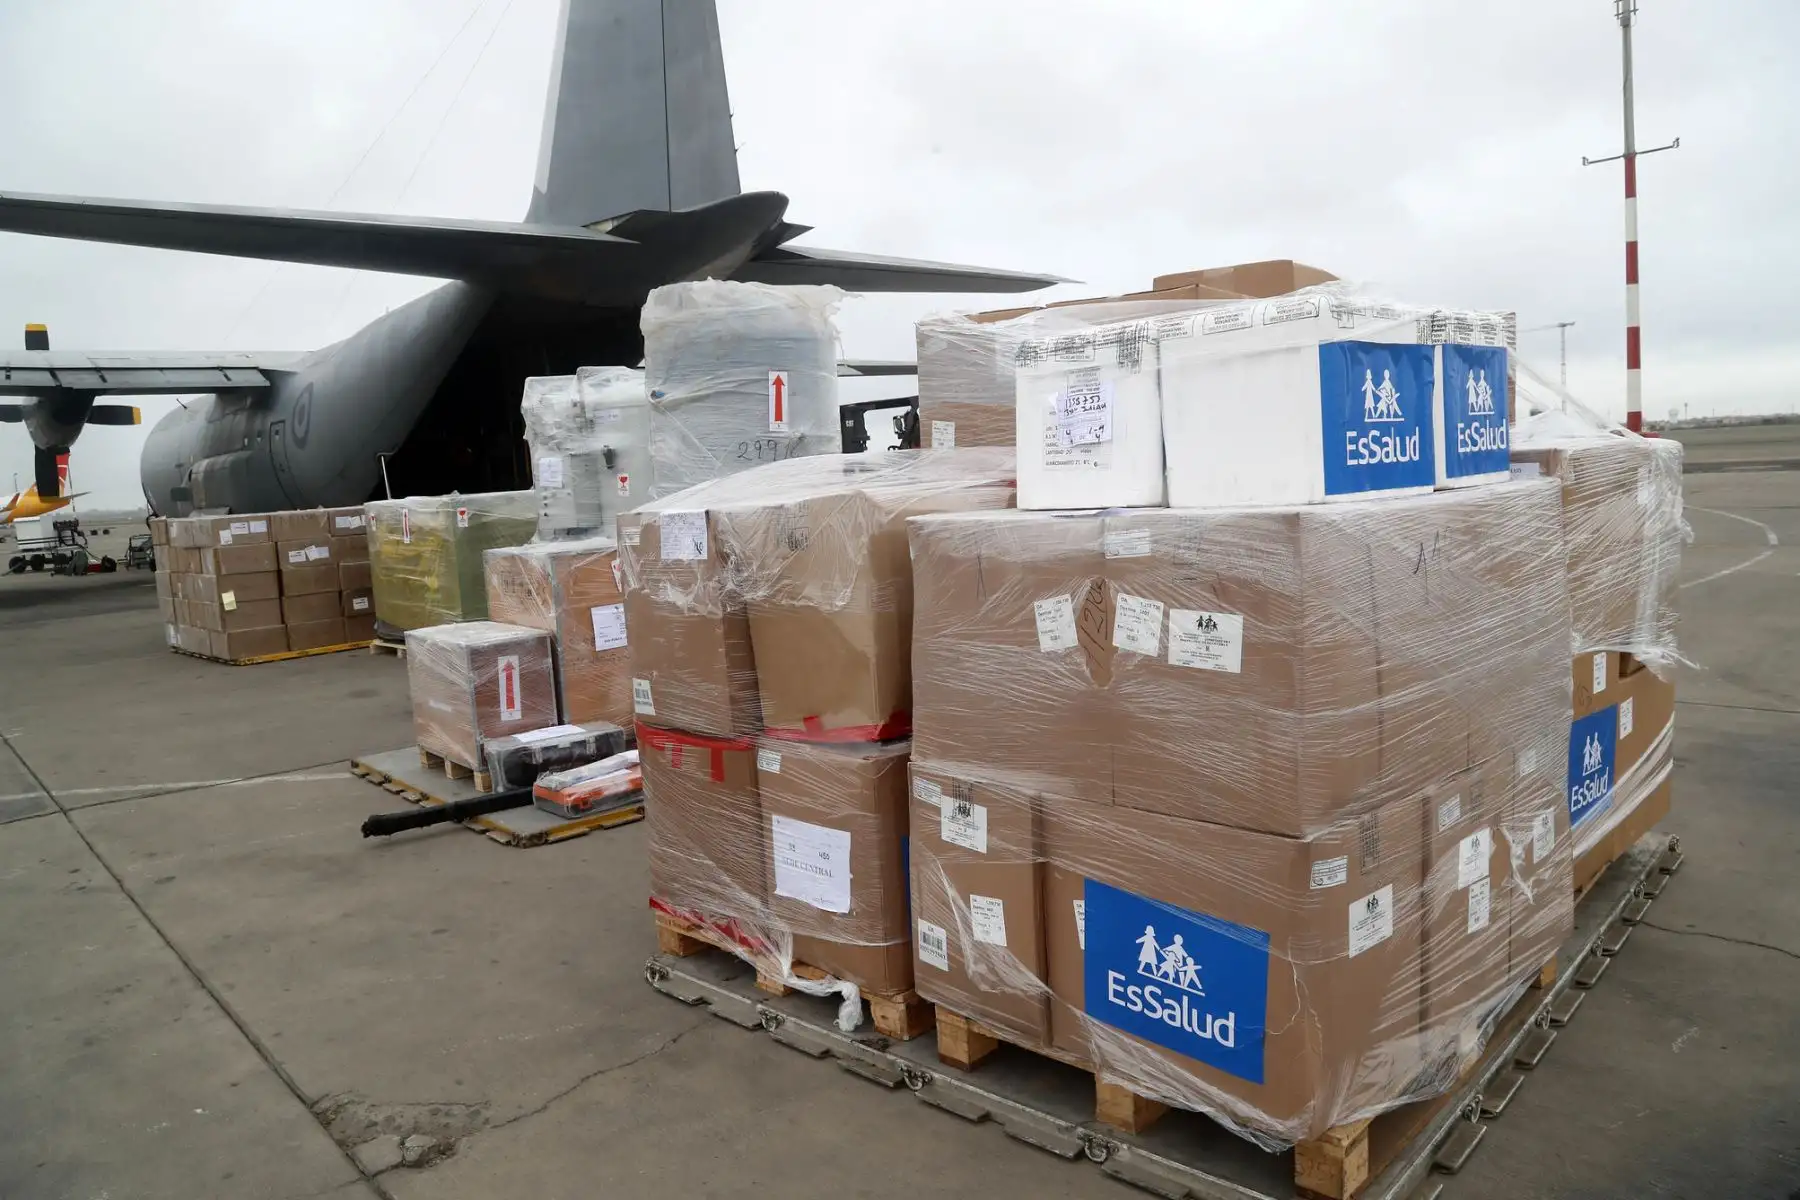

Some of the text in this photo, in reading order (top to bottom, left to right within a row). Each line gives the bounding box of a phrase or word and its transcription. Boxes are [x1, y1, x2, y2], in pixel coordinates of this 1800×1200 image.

[1345, 426, 1420, 466] EsSalud
[1457, 418, 1507, 453] EsSalud
[1570, 767, 1609, 813] EsSalud
[1108, 969, 1235, 1048] EsSalud
